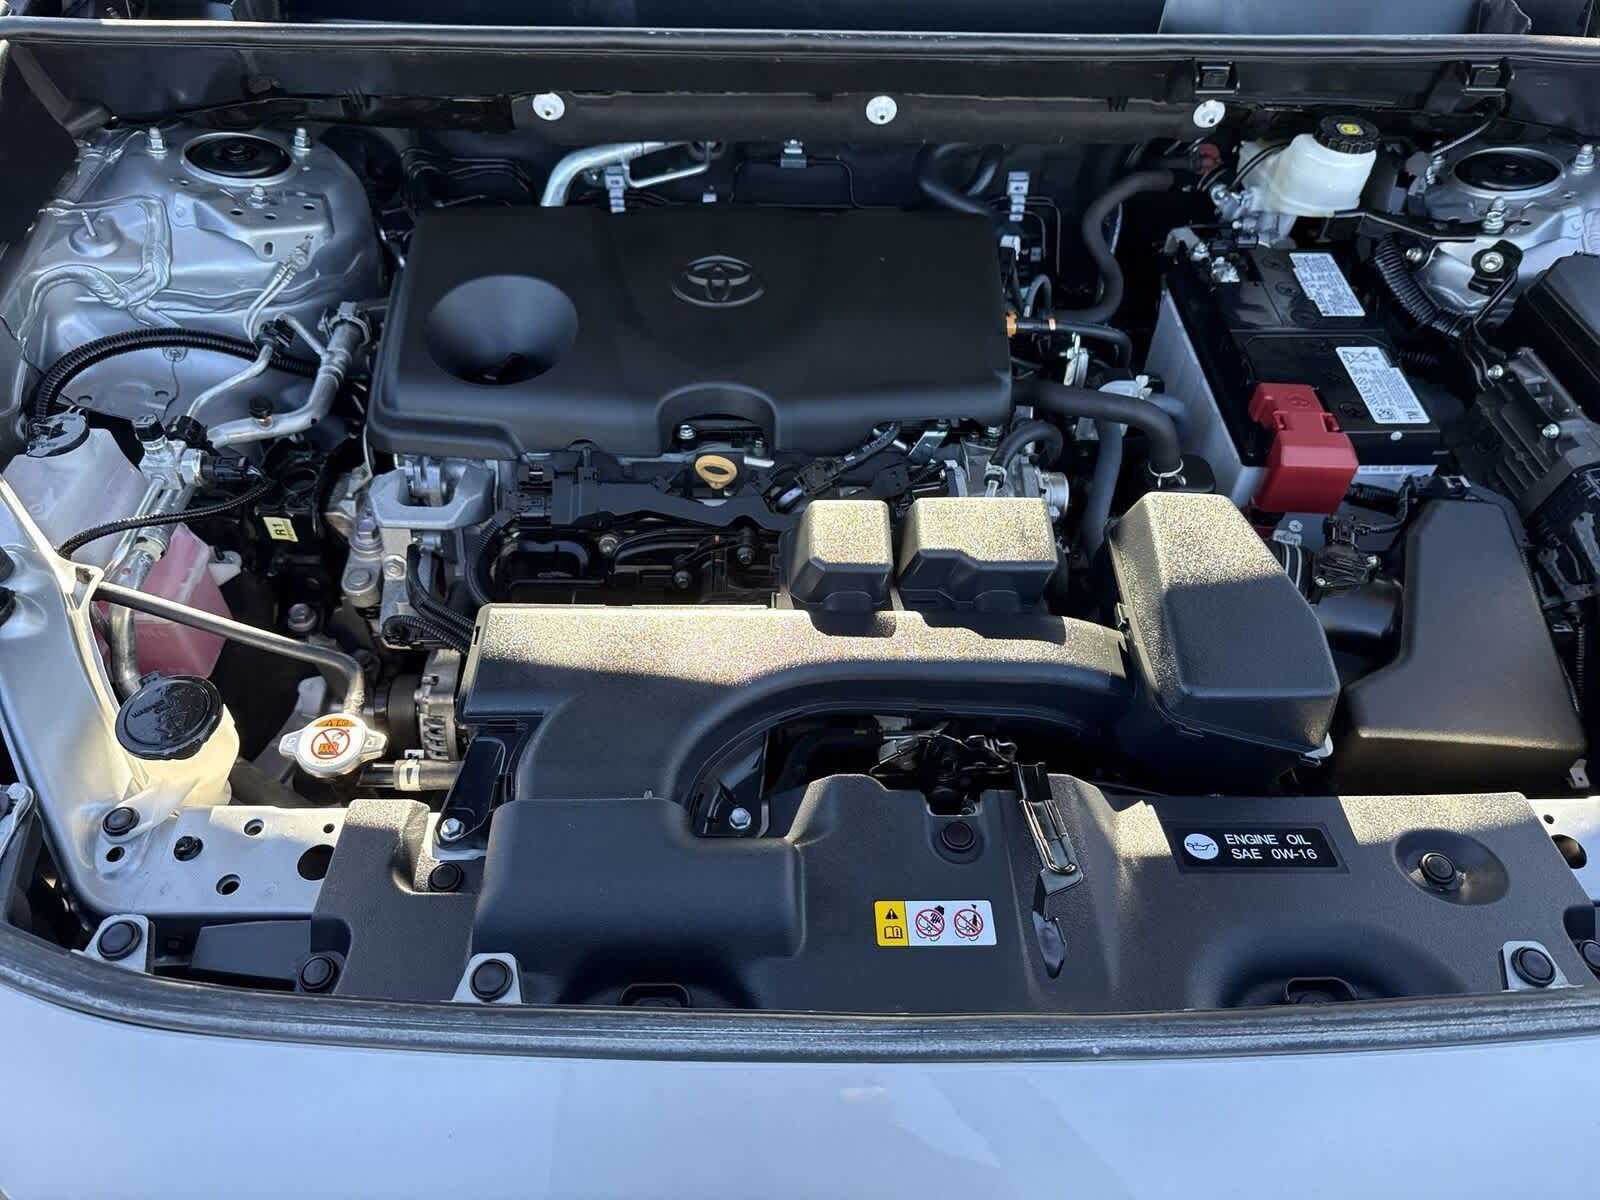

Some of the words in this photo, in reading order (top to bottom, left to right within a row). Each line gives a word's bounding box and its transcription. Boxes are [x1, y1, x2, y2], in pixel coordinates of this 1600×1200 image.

[1223, 833, 1280, 846] ENGINE
[1285, 833, 1313, 846] OIL
[1230, 847, 1264, 860] SAE
[1271, 847, 1319, 860] 0W-16
